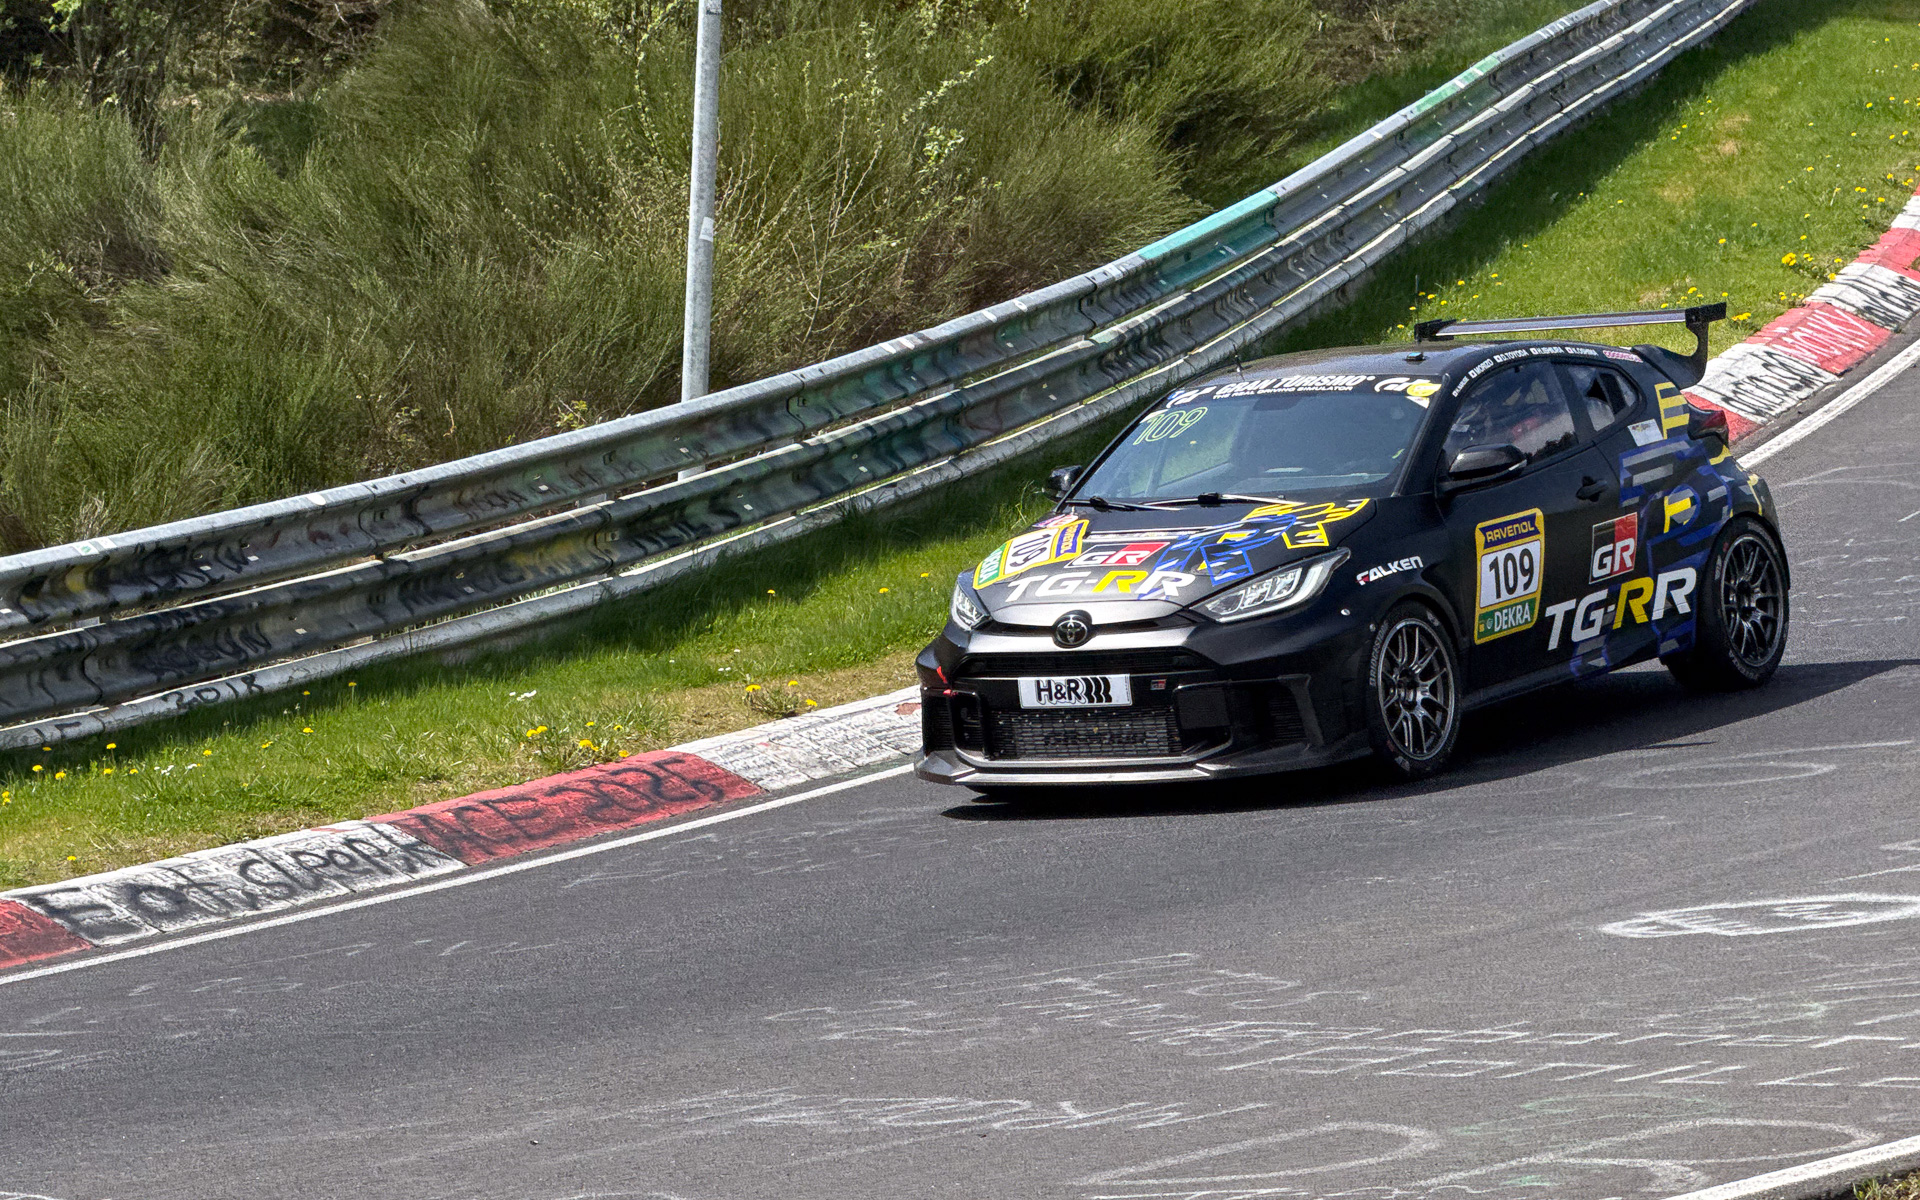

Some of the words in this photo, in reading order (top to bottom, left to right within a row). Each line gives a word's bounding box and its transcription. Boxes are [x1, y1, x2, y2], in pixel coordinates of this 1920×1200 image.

[1216, 379, 1277, 395] GRAN
[1257, 387, 1296, 395] DRIVING
[1133, 407, 1208, 445] 109
[1485, 521, 1535, 542] RAVENOL
[981, 549, 1002, 582] DEKRA
[1009, 533, 1052, 568] 109
[1082, 549, 1151, 565] GR
[1592, 537, 1635, 578] GR
[1356, 555, 1424, 586] FALKEN
[1488, 547, 1534, 600] 109
[1493, 602, 1531, 632] DEKRA
[161, 673, 264, 710] 2018
[1036, 678, 1086, 705] H&R
[545, 758, 726, 825] 2025
